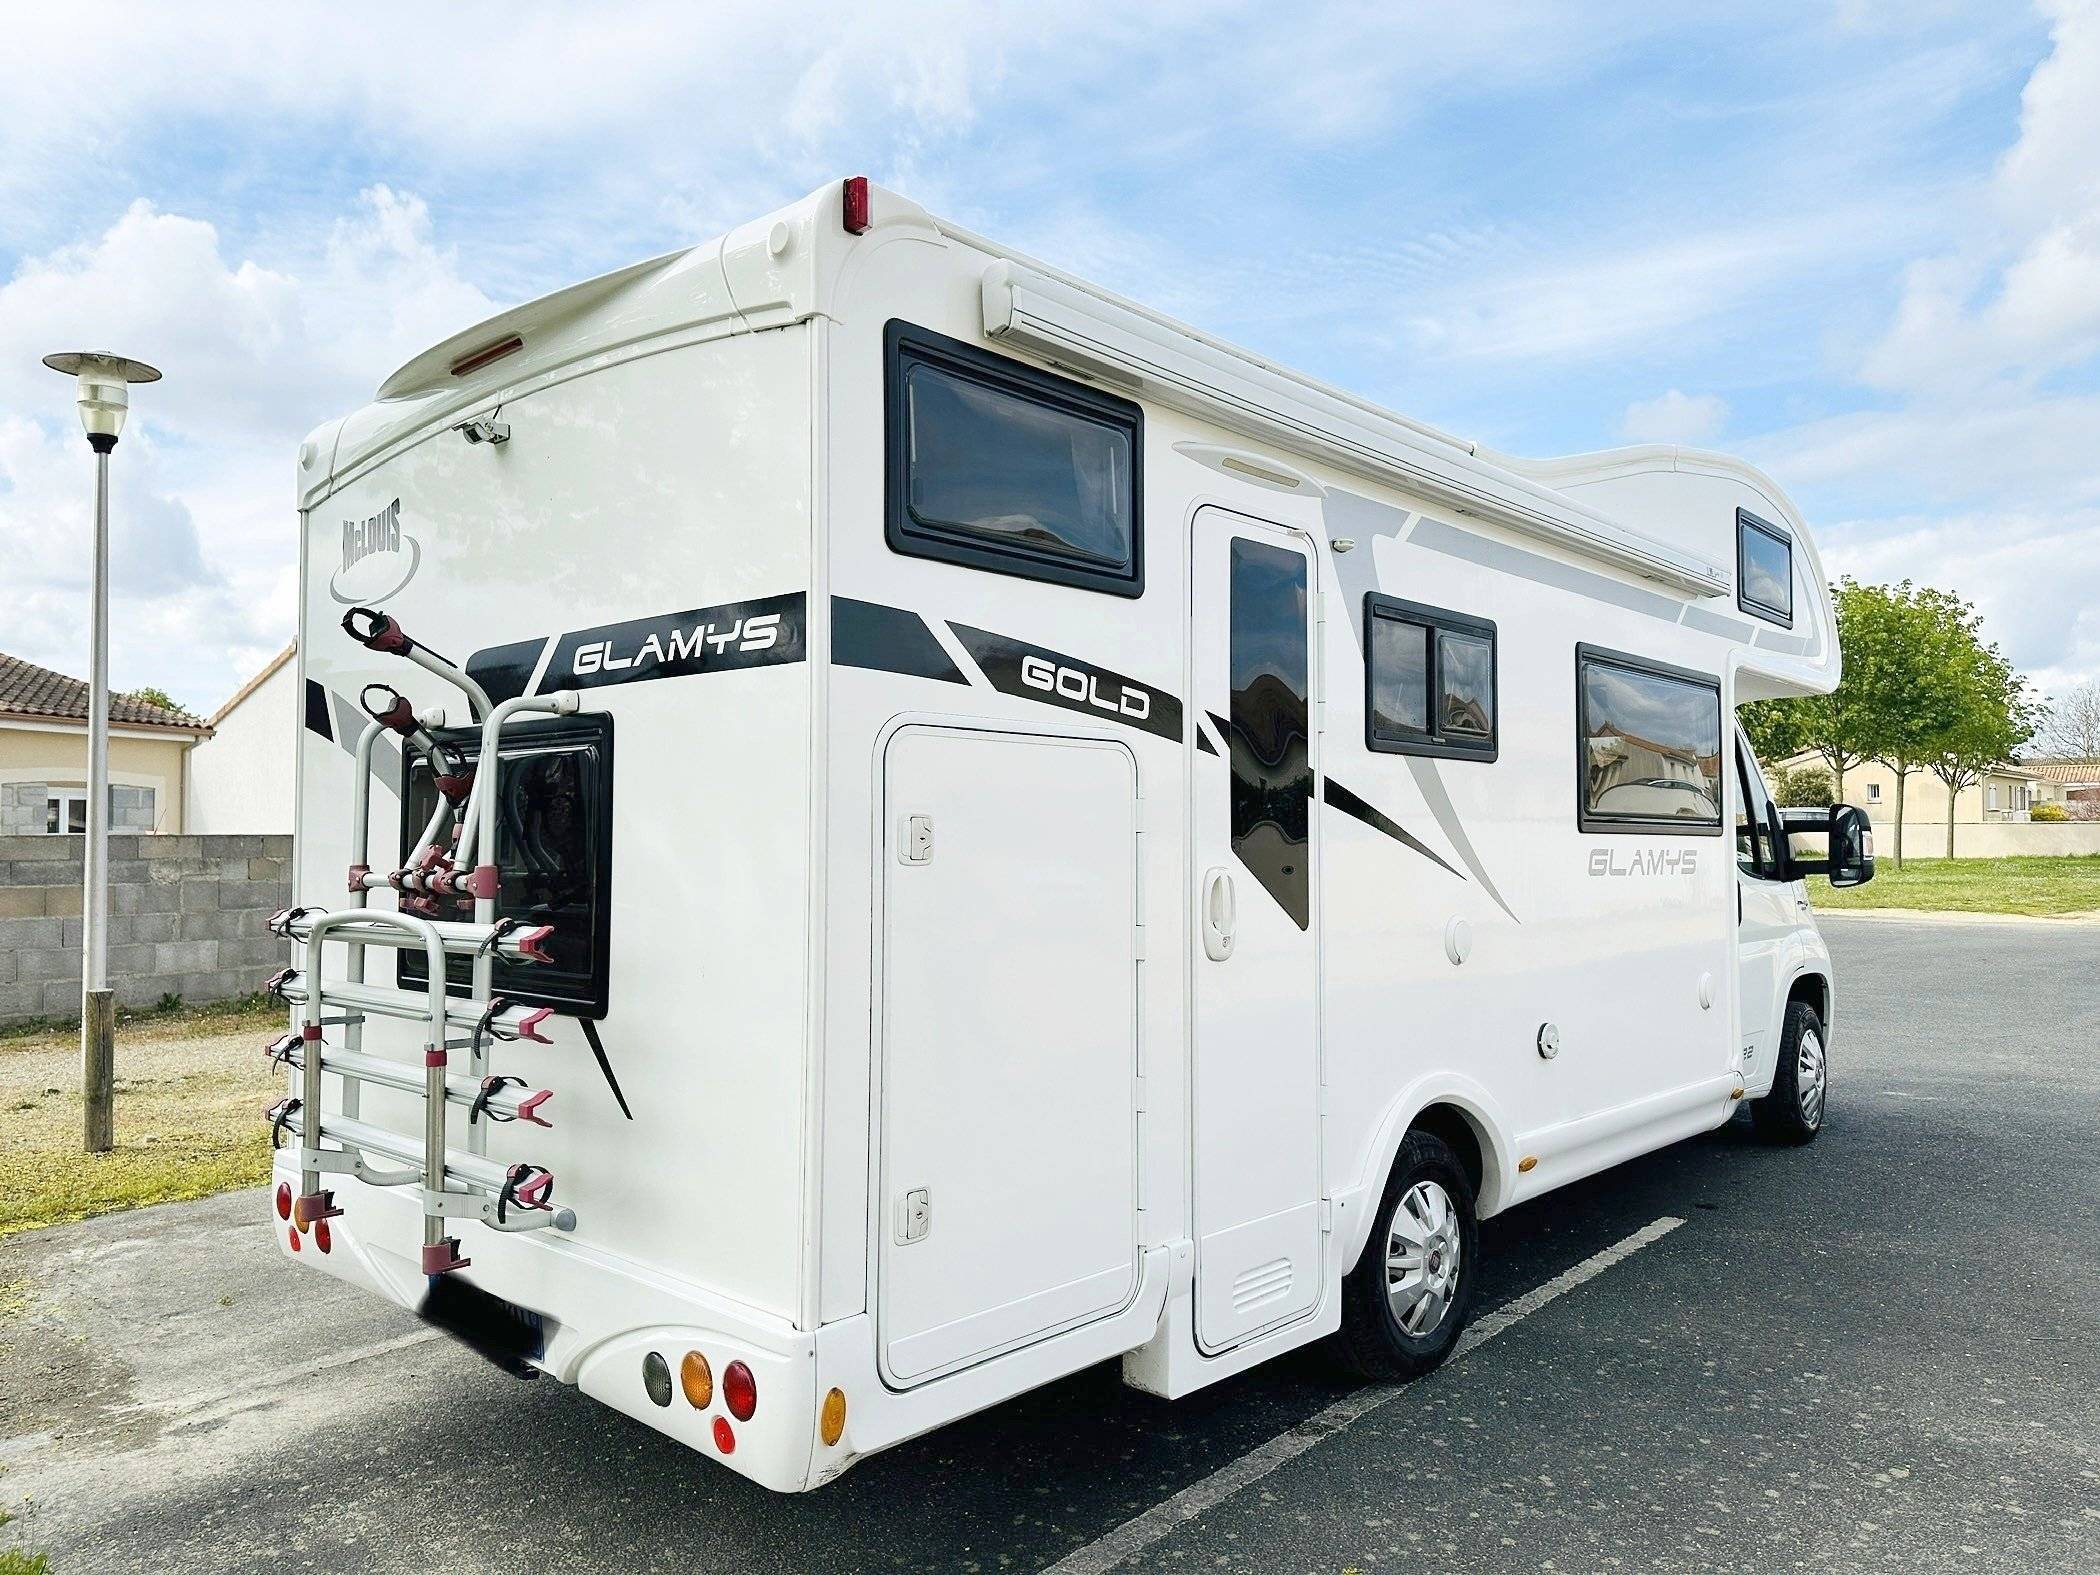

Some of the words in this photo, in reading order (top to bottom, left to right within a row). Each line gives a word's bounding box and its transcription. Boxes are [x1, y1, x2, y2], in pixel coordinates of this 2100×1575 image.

[343, 497, 400, 574] McLOUIS
[573, 613, 781, 676] GLAMYS
[1021, 655, 1150, 720] GOLD
[1588, 848, 1698, 876] GLAMYS
